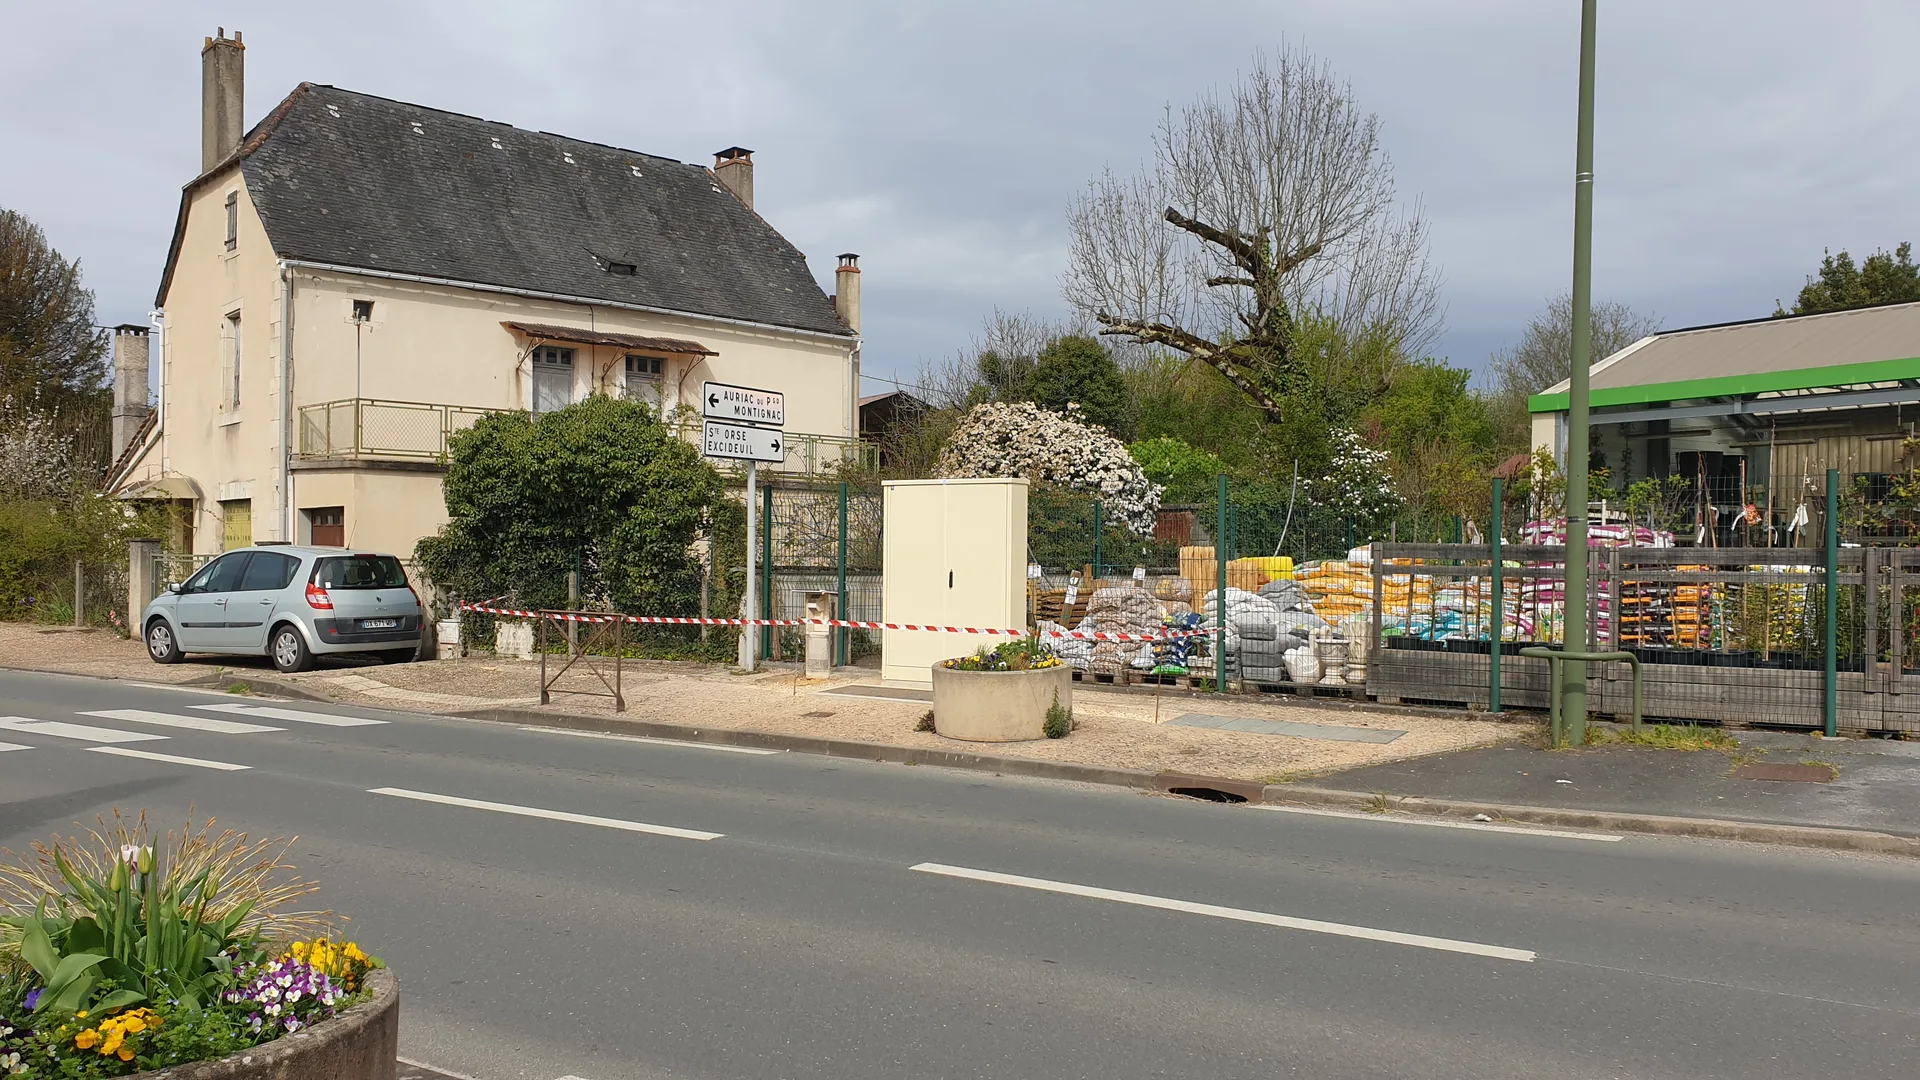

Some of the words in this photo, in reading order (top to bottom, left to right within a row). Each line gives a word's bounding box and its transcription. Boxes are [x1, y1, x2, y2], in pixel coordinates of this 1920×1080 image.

[723, 391, 754, 404] AURIAC
[734, 405, 781, 420] MONTIGNAC
[724, 429, 747, 441] ORSE
[708, 441, 753, 455] EXCIDEUIL
